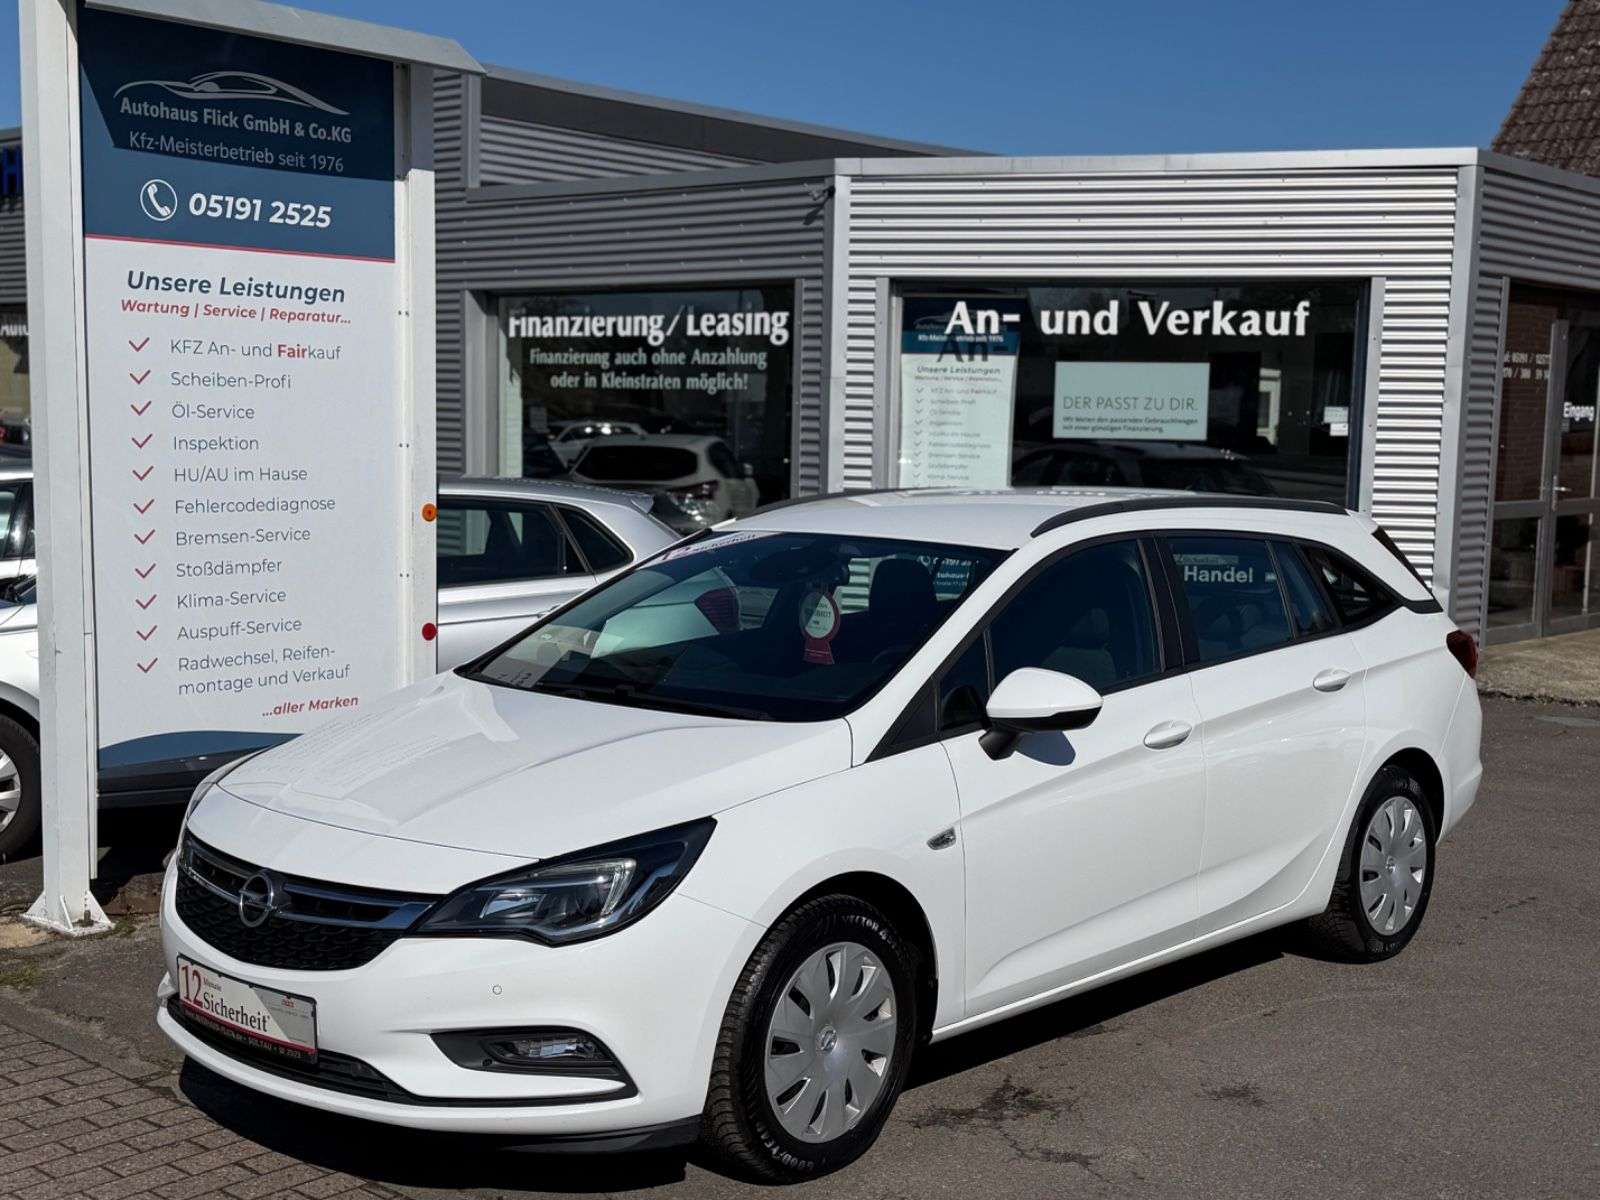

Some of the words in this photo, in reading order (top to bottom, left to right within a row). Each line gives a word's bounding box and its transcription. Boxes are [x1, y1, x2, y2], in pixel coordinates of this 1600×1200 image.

[120, 97, 198, 123] Autohaus
[203, 108, 239, 128] Flick
[243, 115, 290, 135] GmbH
[294, 121, 304, 137] &
[308, 123, 352, 143] Co.KG
[129, 131, 274, 165] Kfz-Meisterbetrieb
[278, 152, 306, 168] seit
[310, 154, 344, 173] 1976
[188, 192, 262, 221] 05191
[269, 201, 332, 229] 2525
[127, 270, 212, 294] Unsere
[220, 277, 345, 304] Leistungen
[121, 300, 190, 318] Wartung
[203, 304, 257, 319] Service
[943, 301, 1020, 335] An-
[1040, 300, 1119, 335] und
[1138, 300, 1310, 336] Verkauf
[686, 304, 790, 346] Leasing
[171, 339, 203, 354] KFZ
[207, 340, 236, 355] An-
[241, 343, 273, 357] und
[276, 345, 343, 361] Fairkauf
[529, 348, 610, 370] Finanzierung
[614, 348, 647, 364] auch
[651, 348, 687, 365] ohne
[691, 348, 767, 370] Anzahlung
[171, 371, 292, 388] Scheiben-Profi
[550, 372, 579, 388] oder
[584, 372, 597, 388] in
[601, 372, 681, 389] Kleinstraten
[686, 372, 748, 395] möglich!
[171, 400, 255, 419] Öl-Service
[1062, 395, 1093, 411] DER
[1096, 396, 1138, 411] PASST
[1143, 396, 1165, 411] ZU
[1563, 402, 1594, 421] Eingang
[173, 436, 259, 453] Inspektion
[174, 466, 229, 484] HU/AU
[234, 468, 254, 482] im
[259, 467, 308, 482] Hause
[175, 497, 336, 515] Fehlercodediagnose
[176, 528, 311, 547] Bremsen-Service
[176, 558, 282, 578] Stoßdämpfer
[1183, 565, 1254, 583] Handel
[177, 588, 287, 609] Klima-Service
[177, 617, 302, 640] Auspuff-Service
[178, 650, 278, 673] Radwechsel,
[282, 644, 336, 663] Reifen-
[178, 675, 253, 697] montage
[258, 670, 289, 689] und
[293, 663, 352, 685] Verkauf
[308, 696, 359, 713] Marken
[181, 965, 204, 1008] 12
